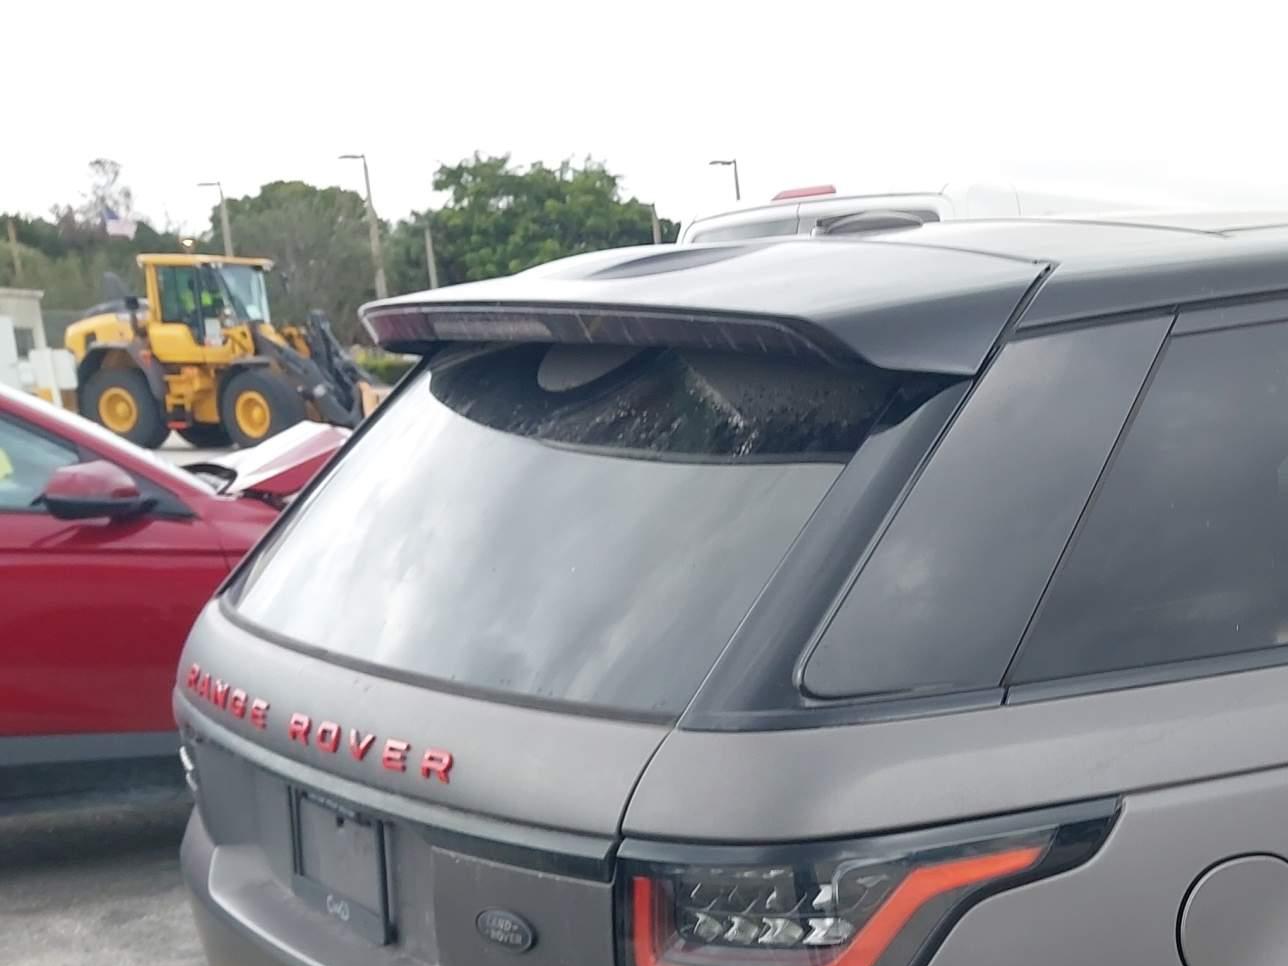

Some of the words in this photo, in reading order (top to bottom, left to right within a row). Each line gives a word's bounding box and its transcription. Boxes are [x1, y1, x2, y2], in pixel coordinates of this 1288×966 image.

[187, 663, 270, 730] RANGE
[289, 712, 454, 784] ROVER
[490, 928, 523, 945] ROVER
